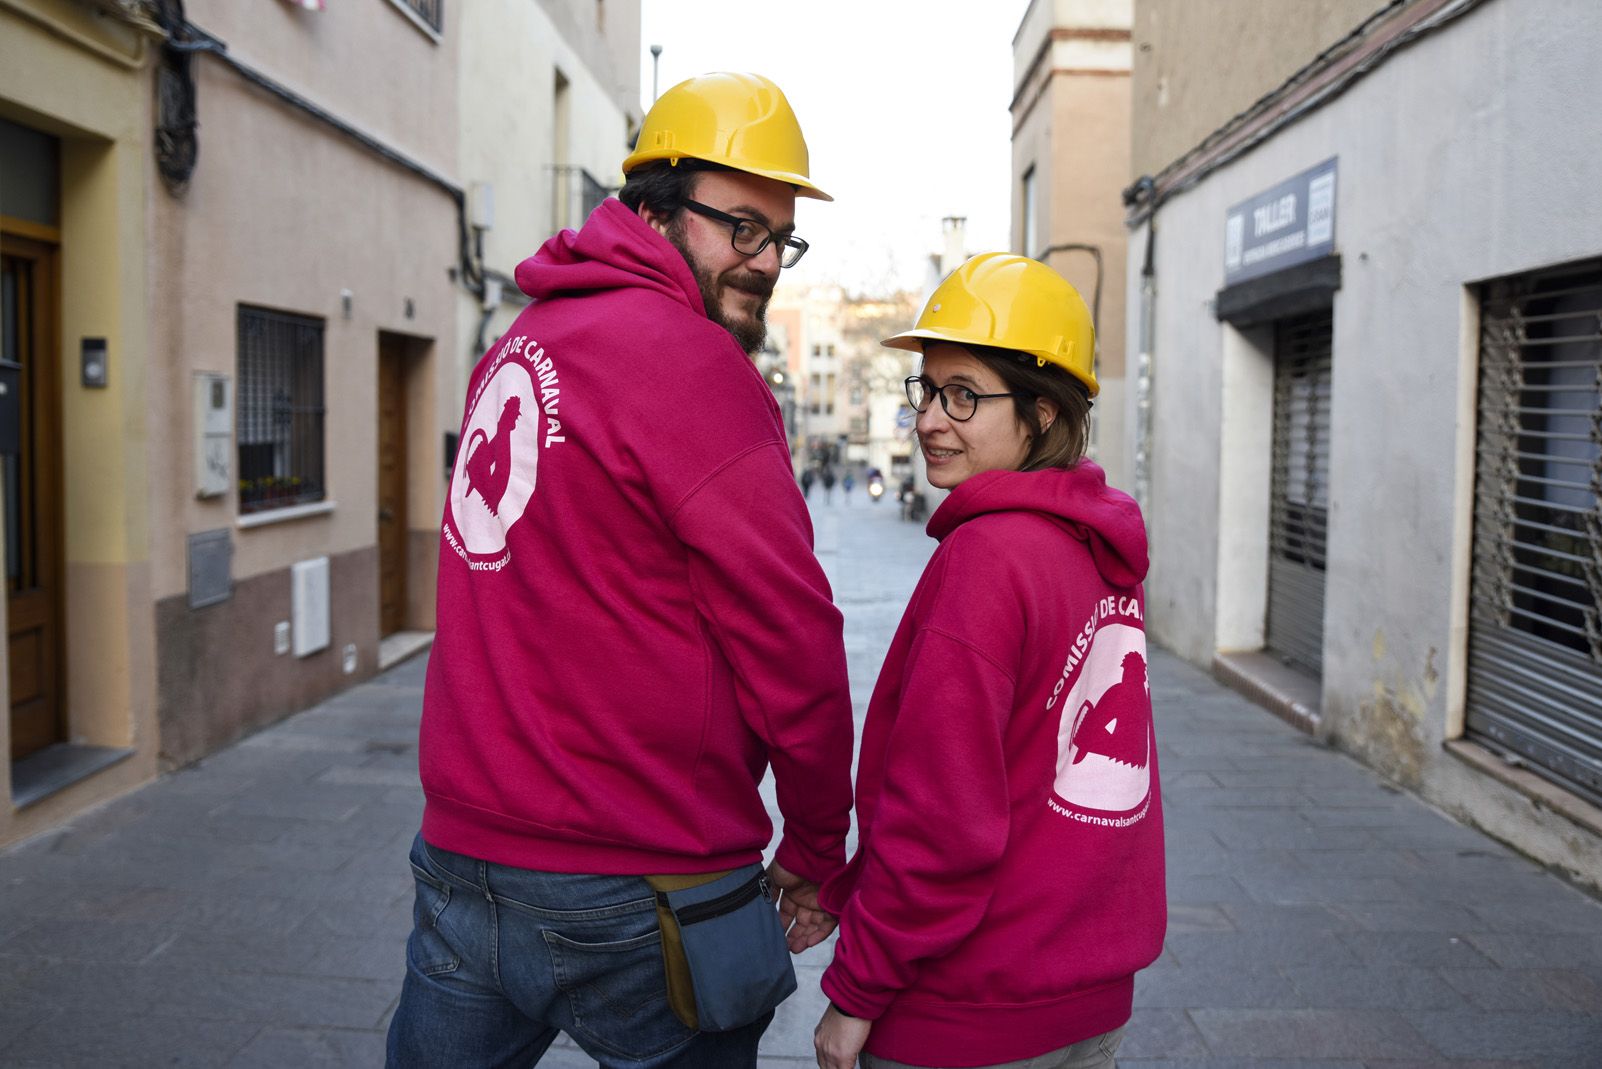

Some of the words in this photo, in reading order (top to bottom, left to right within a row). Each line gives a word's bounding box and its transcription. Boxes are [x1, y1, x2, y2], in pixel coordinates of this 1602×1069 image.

[510, 336, 527, 354] DE
[524, 341, 565, 448] CARNAVAL
[1100, 596, 1116, 619] DE
